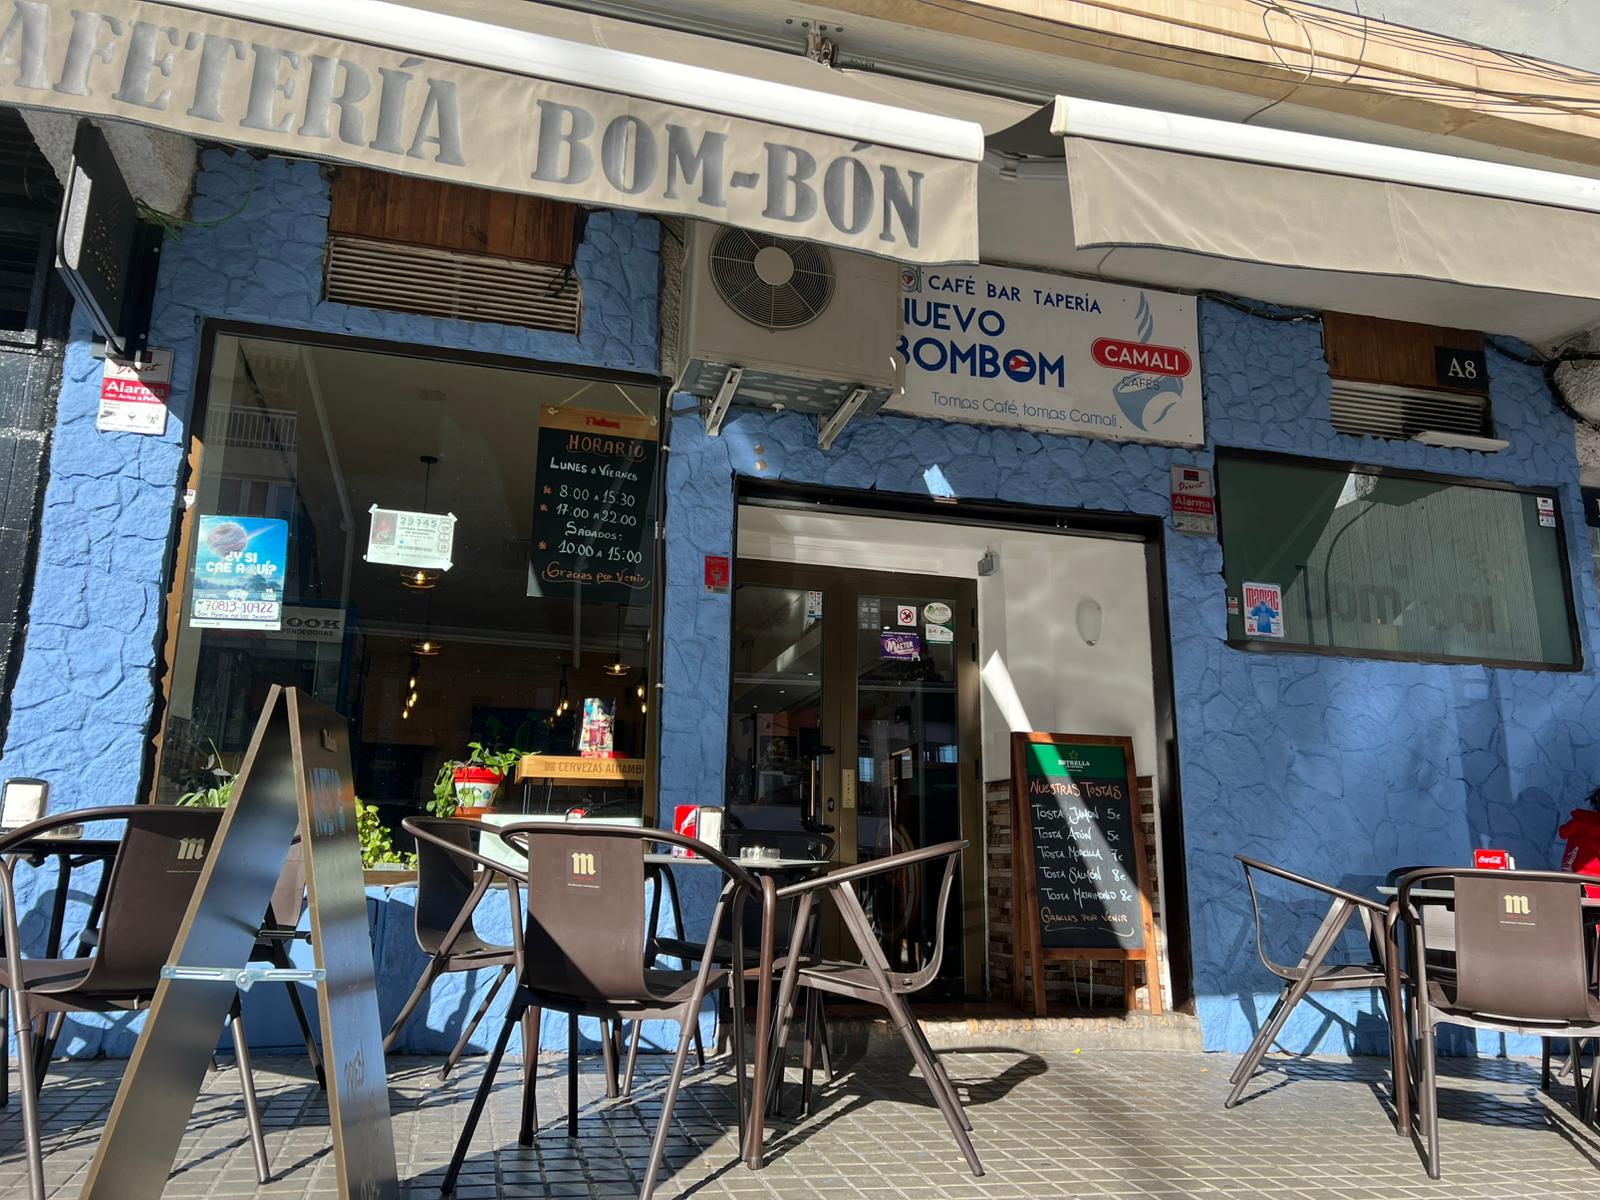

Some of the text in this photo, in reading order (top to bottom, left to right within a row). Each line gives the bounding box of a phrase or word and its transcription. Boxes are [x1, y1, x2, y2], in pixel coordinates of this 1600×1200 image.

[531, 98, 925, 249] BOM-BÓN
[928, 275, 1102, 314] CAFÉ BAR TAPERÍA
[1105, 345, 1179, 371] CAMALI
[1448, 357, 1477, 380] A8
[106, 380, 165, 397] Alarma
[1122, 376, 1161, 391] CAFÉS
[932, 392, 1117, 429] Tomas Café, tomas Camali
[550, 456, 588, 474] LUNES
[559, 484, 590, 501] 8:00
[602, 489, 636, 507] 15:30
[1174, 495, 1211, 509] Alarma
[556, 503, 589, 519] 17:00
[600, 509, 637, 527] 22:00
[244, 552, 258, 563] SI
[558, 540, 594, 557] 10:00
[607, 546, 643, 564] 15:00
[206, 562, 232, 573] CAE
[284, 617, 341, 629] OOK
[558, 761, 645, 775] CERVEZAS ALHAMB
